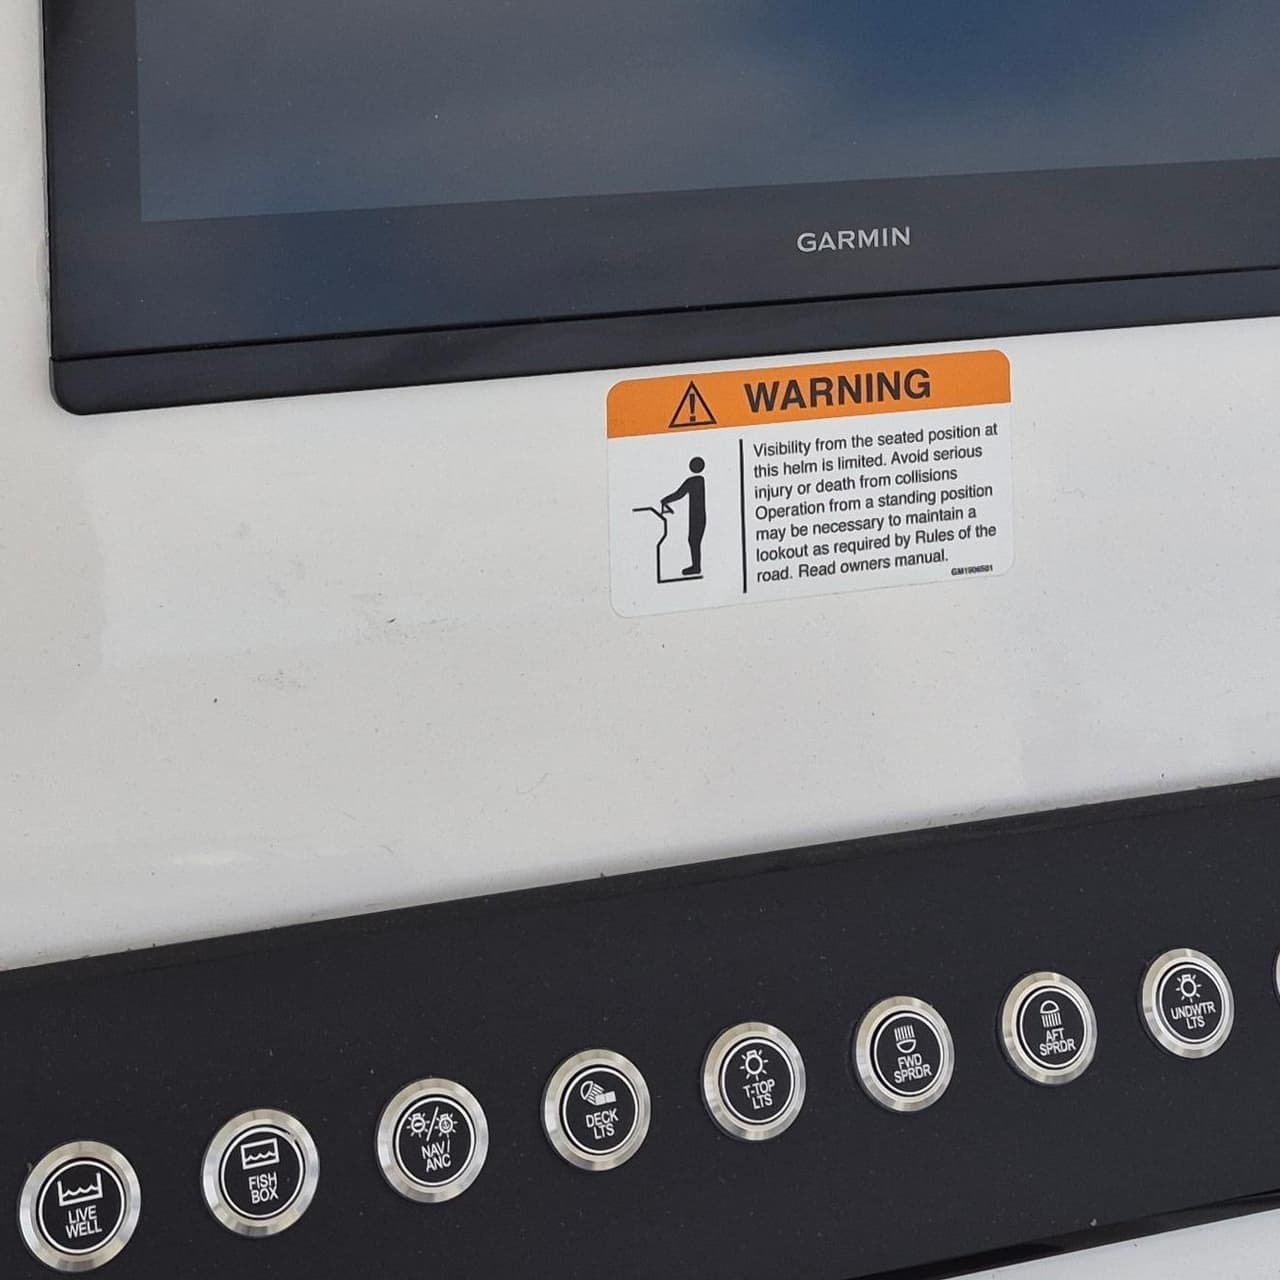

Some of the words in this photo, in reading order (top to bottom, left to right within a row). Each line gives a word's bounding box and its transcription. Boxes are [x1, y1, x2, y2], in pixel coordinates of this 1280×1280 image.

[796, 226, 912, 253] GARMIN
[744, 369, 932, 413] WARNING
[753, 438, 812, 458] Visibility
[815, 436, 847, 453] from
[851, 434, 873, 449] the
[877, 430, 924, 445] seated
[928, 424, 980, 441] position
[985, 422, 998, 437] at
[753, 463, 779, 478] this
[783, 458, 818, 475] helm
[822, 457, 833, 472] is
[837, 453, 887, 471] limited.
[891, 449, 929, 466] Avoid
[933, 446, 982, 461] serious
[755, 483, 792, 501] injury
[797, 479, 812, 495] or
[815, 477, 855, 495] death
[859, 473, 890, 488] from
[895, 468, 957, 486] collisions
[756, 502, 825, 521] Operation
[829, 497, 861, 512] from
[866, 496, 874, 508] a
[877, 490, 937, 511] standing
[940, 484, 993, 503] position
[756, 525, 787, 543] may
[791, 521, 808, 538] be
[813, 516, 884, 533] necessary
[888, 512, 902, 527] to
[905, 508, 964, 525] maintain
[968, 506, 976, 517] a
[756, 545, 809, 562] lookout
[813, 543, 830, 556] as
[834, 535, 890, 557] required
[895, 533, 912, 550] by
[915, 530, 955, 546] Rules
[958, 526, 971, 541] of
[975, 523, 996, 539] the
[757, 566, 793, 583] road.
[799, 563, 837, 579] Read
[841, 558, 891, 576] owners
[895, 549, 948, 569] manual.
[1171, 1001, 1216, 1020] UNDWTR
[1186, 1016, 1205, 1030] LTS
[1046, 1028, 1064, 1042] AFT
[1039, 1038, 1076, 1056] SPRDR
[898, 1053, 922, 1070] FWD
[894, 1064, 932, 1083] SPRDR
[743, 1079, 775, 1099] T-TOP
[752, 1094, 773, 1110] LTS
[585, 1108, 619, 1128] DECK
[594, 1124, 615, 1140] LTS
[426, 1154, 451, 1172] ANC
[248, 1172, 278, 1191] FISH
[251, 1186, 279, 1204] BOX
[68, 1205, 97, 1225] LIVE
[66, 1220, 102, 1238] WELL
